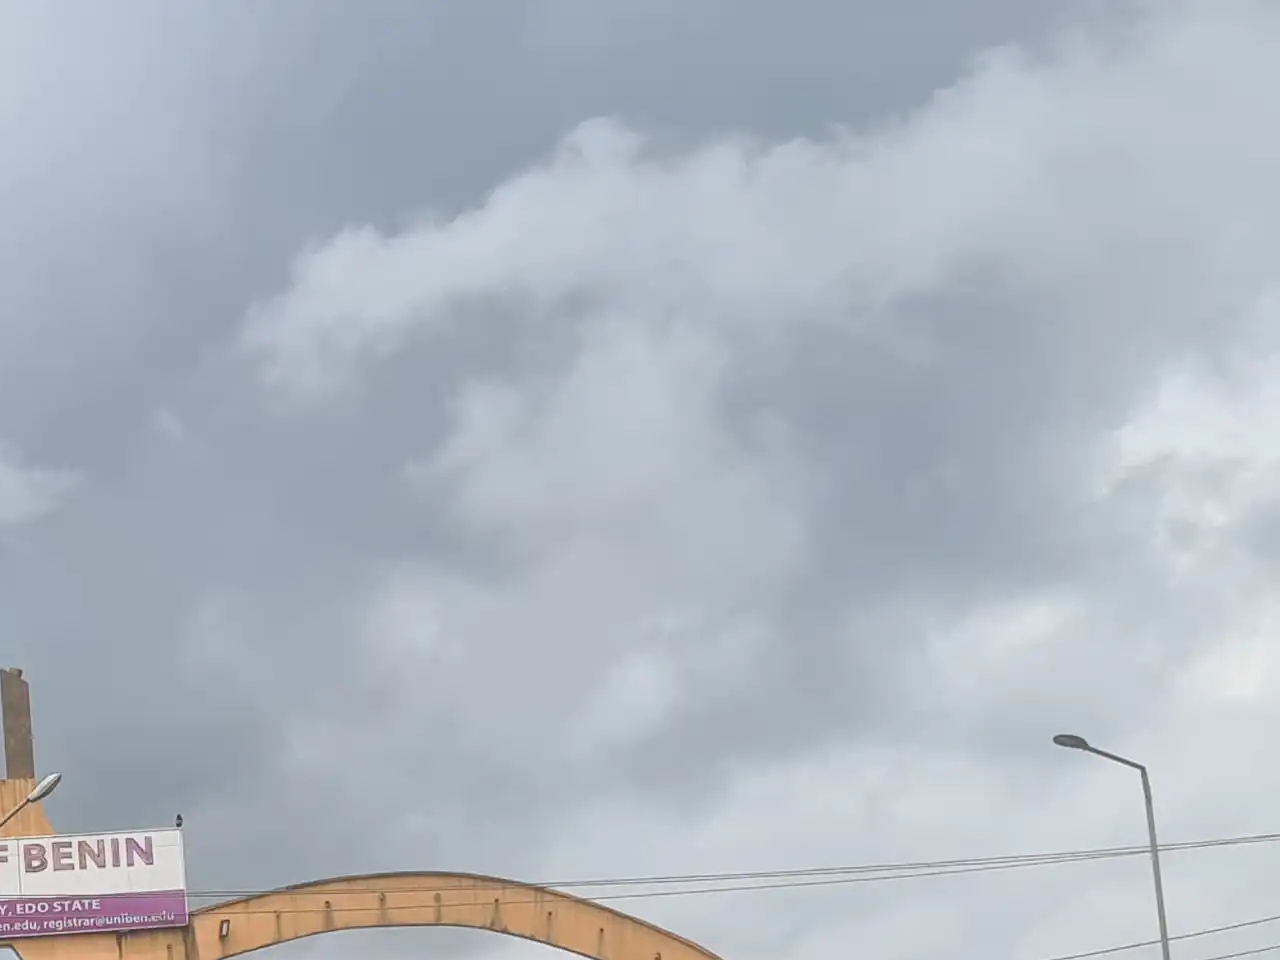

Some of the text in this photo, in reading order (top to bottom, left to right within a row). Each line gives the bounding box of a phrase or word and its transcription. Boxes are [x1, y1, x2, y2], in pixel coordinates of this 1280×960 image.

[24, 836, 154, 873] BENIN
[16, 902, 49, 915] EDO
[52, 899, 101, 913] STATE
